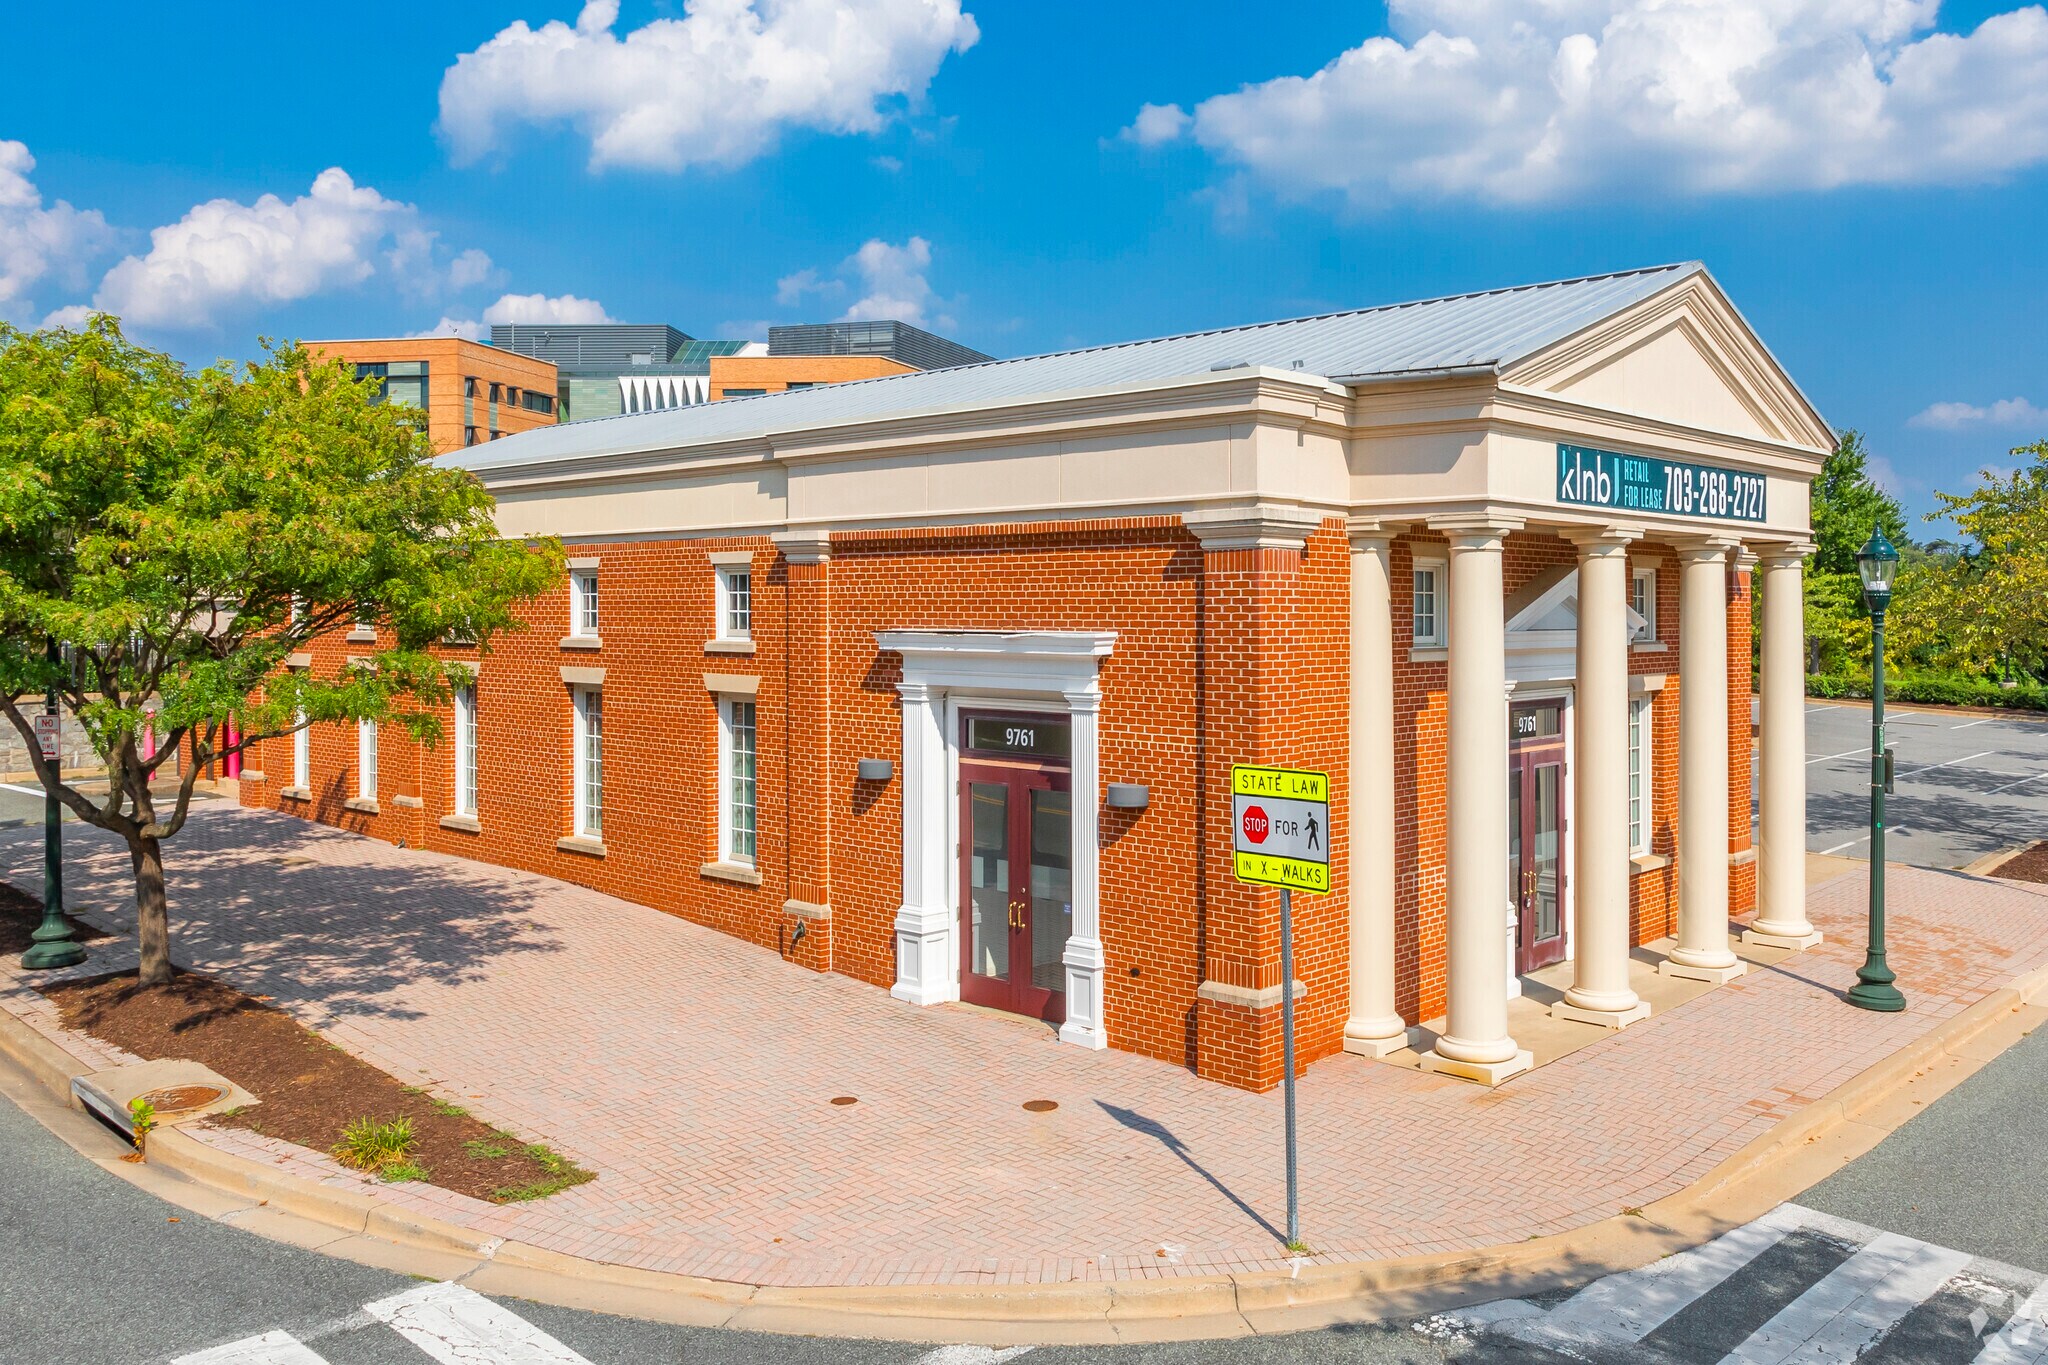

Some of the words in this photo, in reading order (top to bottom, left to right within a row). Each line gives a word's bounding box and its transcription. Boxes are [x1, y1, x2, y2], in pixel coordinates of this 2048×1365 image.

[1562, 450, 1611, 504] klnb
[1624, 459, 1649, 483] RETAIL
[1624, 485, 1639, 507] FOR
[1640, 487, 1663, 510] LEASE
[1664, 466, 1765, 519] 703-268-2727
[1518, 715, 1537, 733] 9761
[1006, 728, 1034, 747] 9761
[1242, 774, 1282, 792] STATE
[1292, 778, 1319, 795] LAW
[1244, 817, 1268, 833] STOP
[1275, 819, 1299, 837] FOR
[1243, 860, 1252, 872] IN
